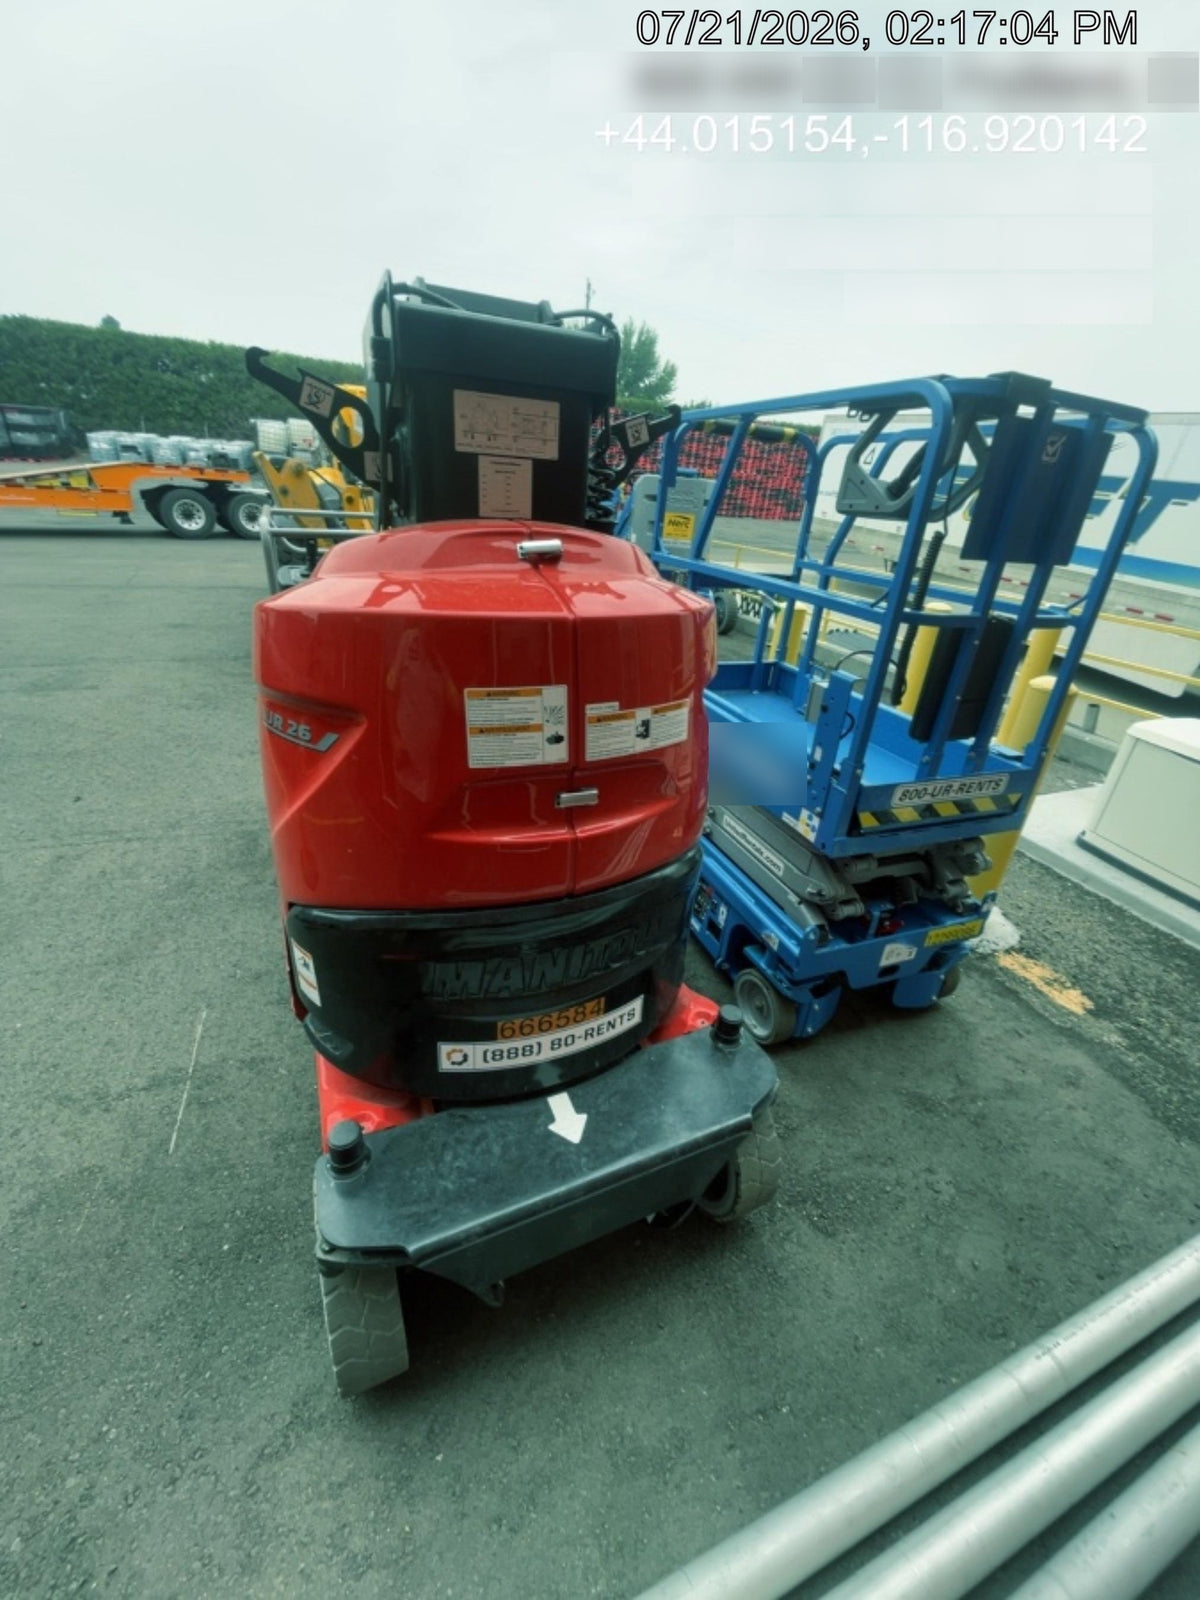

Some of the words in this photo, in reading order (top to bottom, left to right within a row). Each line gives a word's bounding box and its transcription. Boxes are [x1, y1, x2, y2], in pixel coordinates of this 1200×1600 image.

[286, 720, 312, 741] 26
[899, 778, 1004, 802] 800-UR-RENTS
[501, 998, 604, 1038] 666584
[483, 1041, 542, 1063] (888)
[550, 1007, 637, 1052] 80-RENTS
